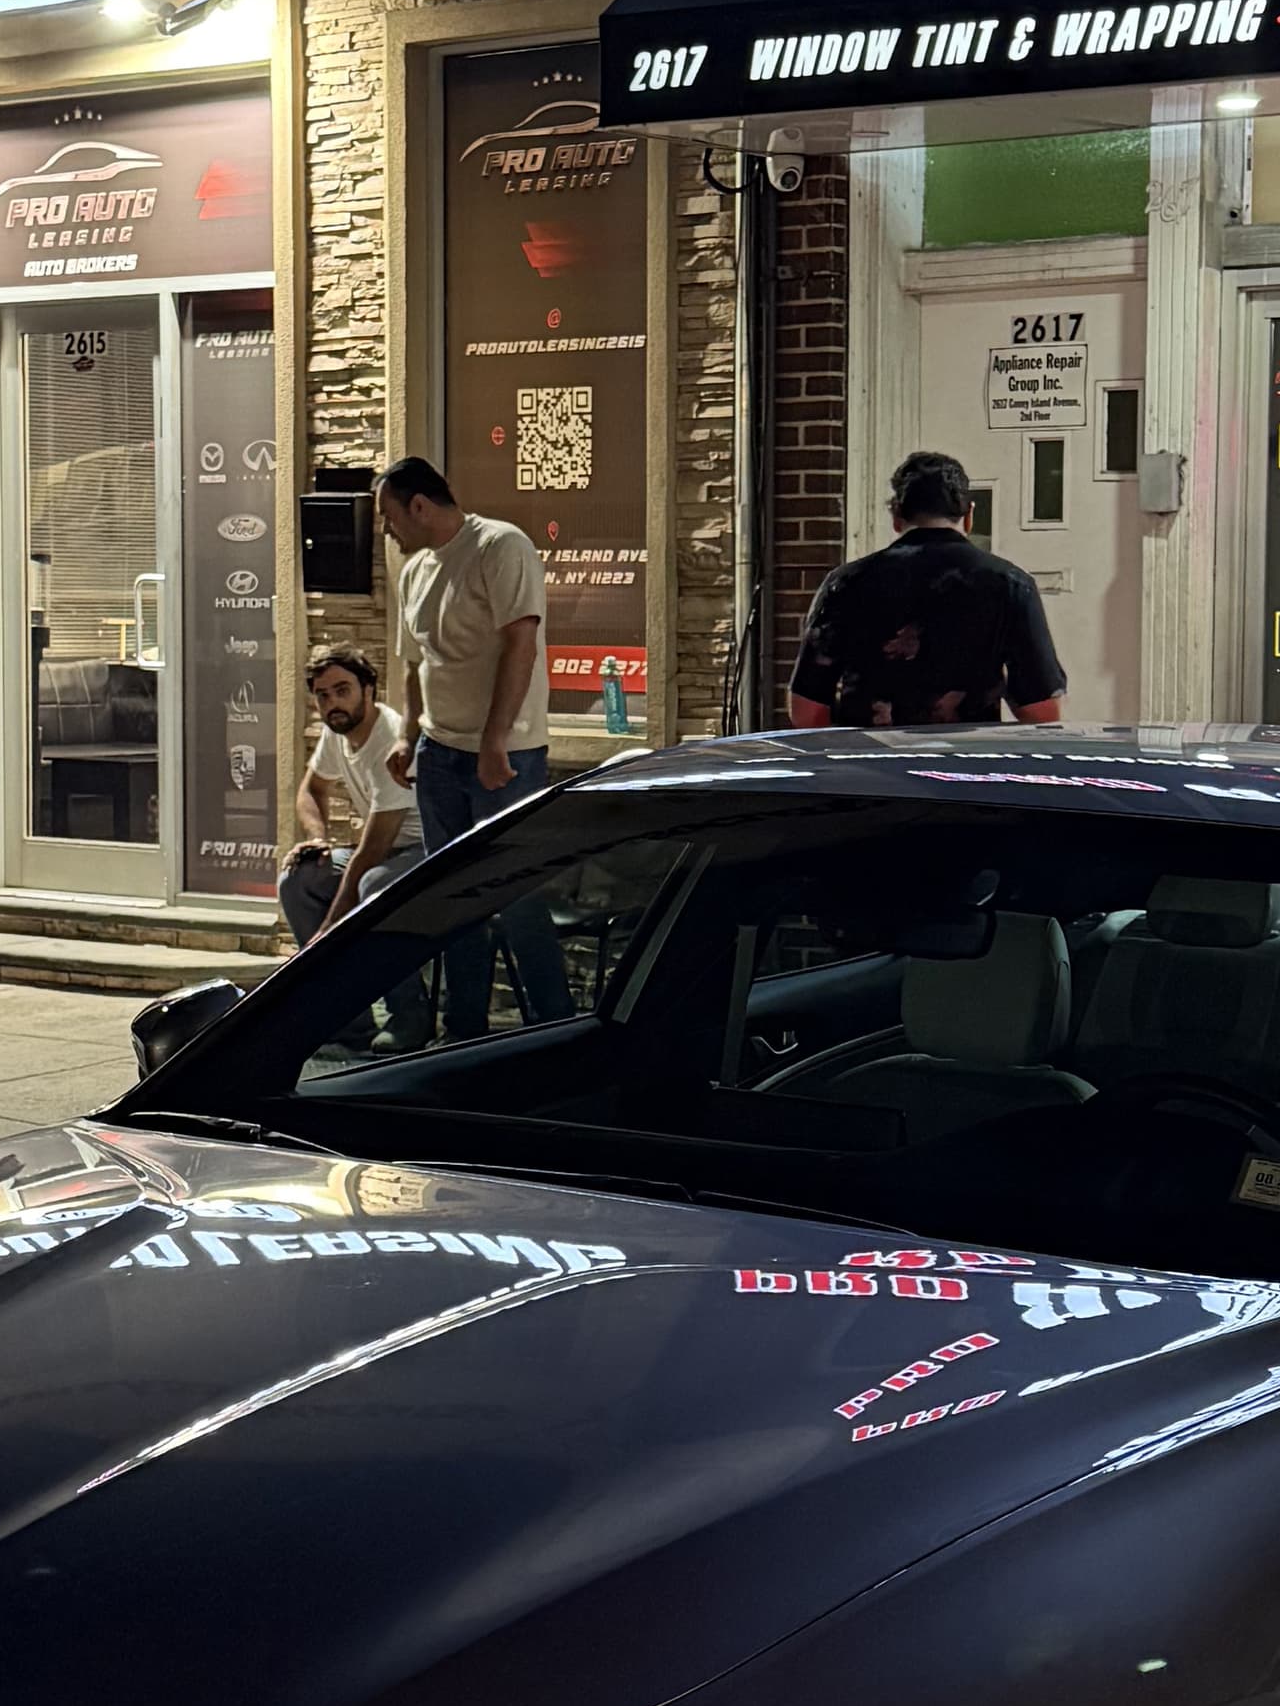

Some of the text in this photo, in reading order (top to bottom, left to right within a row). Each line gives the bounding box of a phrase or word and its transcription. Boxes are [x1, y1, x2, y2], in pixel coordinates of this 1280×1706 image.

[628, 45, 708, 92] 2617
[748, 27, 901, 81] WINDOW
[912, 18, 999, 68] TINT
[1008, 15, 1035, 60] &
[482, 138, 637, 176] PRO AUTO
[504, 172, 612, 193] LEASING
[5, 188, 158, 228] PRO AUTO
[28, 226, 134, 249] LEASING
[24, 254, 138, 277] AUTO BROKERS
[1013, 313, 1084, 344] 2617
[65, 330, 107, 355] 2615
[465, 335, 646, 356] PROAUTOLEASING2615
[992, 351, 1083, 375] Appliance Repair
[1008, 373, 1063, 394] Group Inc.
[555, 549, 614, 562] ISLAND
[565, 571, 587, 584] NY
[590, 571, 635, 584] 11223
[215, 597, 270, 609] HYUNDAI
[225, 636, 258, 656] Jeep
[552, 658, 594, 674] 902
[200, 840, 236, 856] PRO
